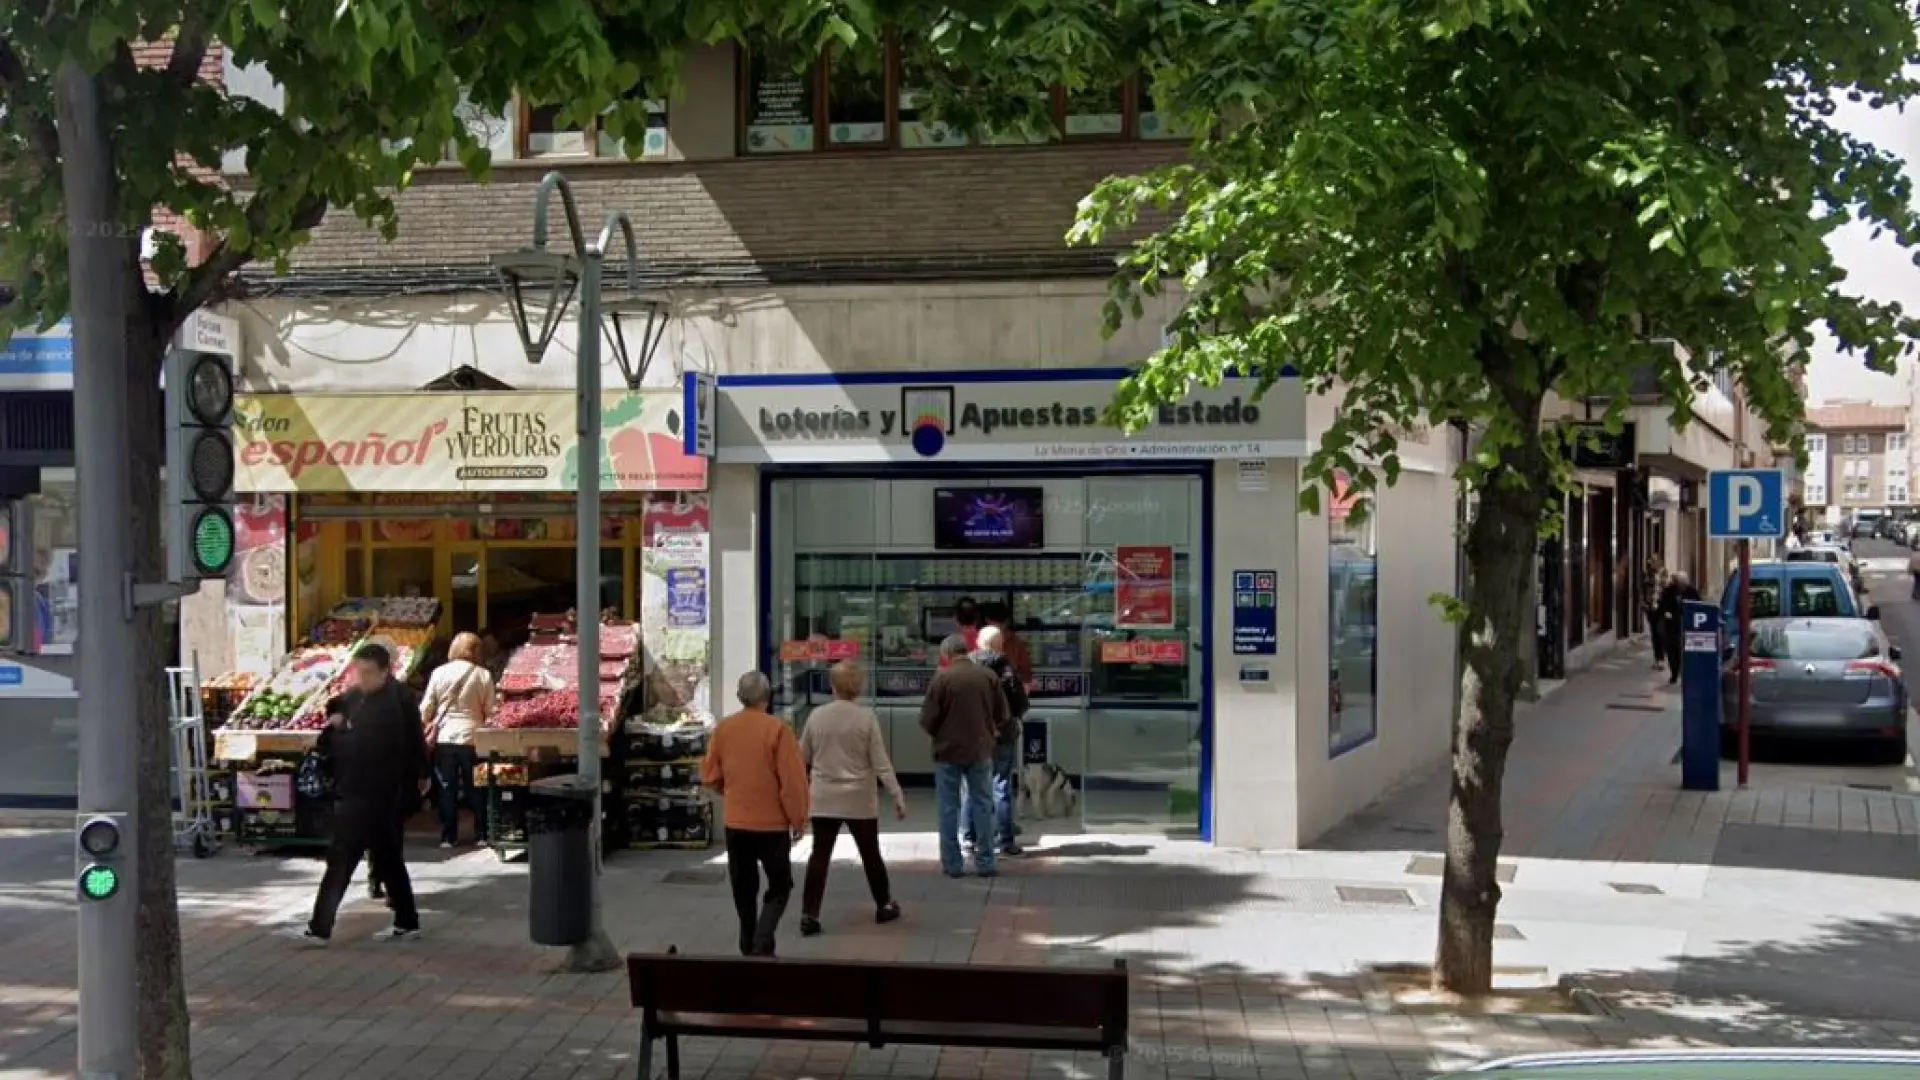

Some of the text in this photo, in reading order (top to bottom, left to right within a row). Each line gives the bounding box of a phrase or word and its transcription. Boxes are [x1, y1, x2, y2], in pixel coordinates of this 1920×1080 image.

[247, 409, 290, 432] don
[463, 407, 547, 436] FRUTAS
[759, 396, 1260, 435] Loterías y Apuestas Estado
[241, 420, 438, 479] español
[457, 432, 561, 460] VERDURAS
[1141, 440, 1225, 456] Administración
[1248, 441, 1261, 454] 14
[1728, 475, 1762, 531] P
[1693, 613, 1708, 629] P
